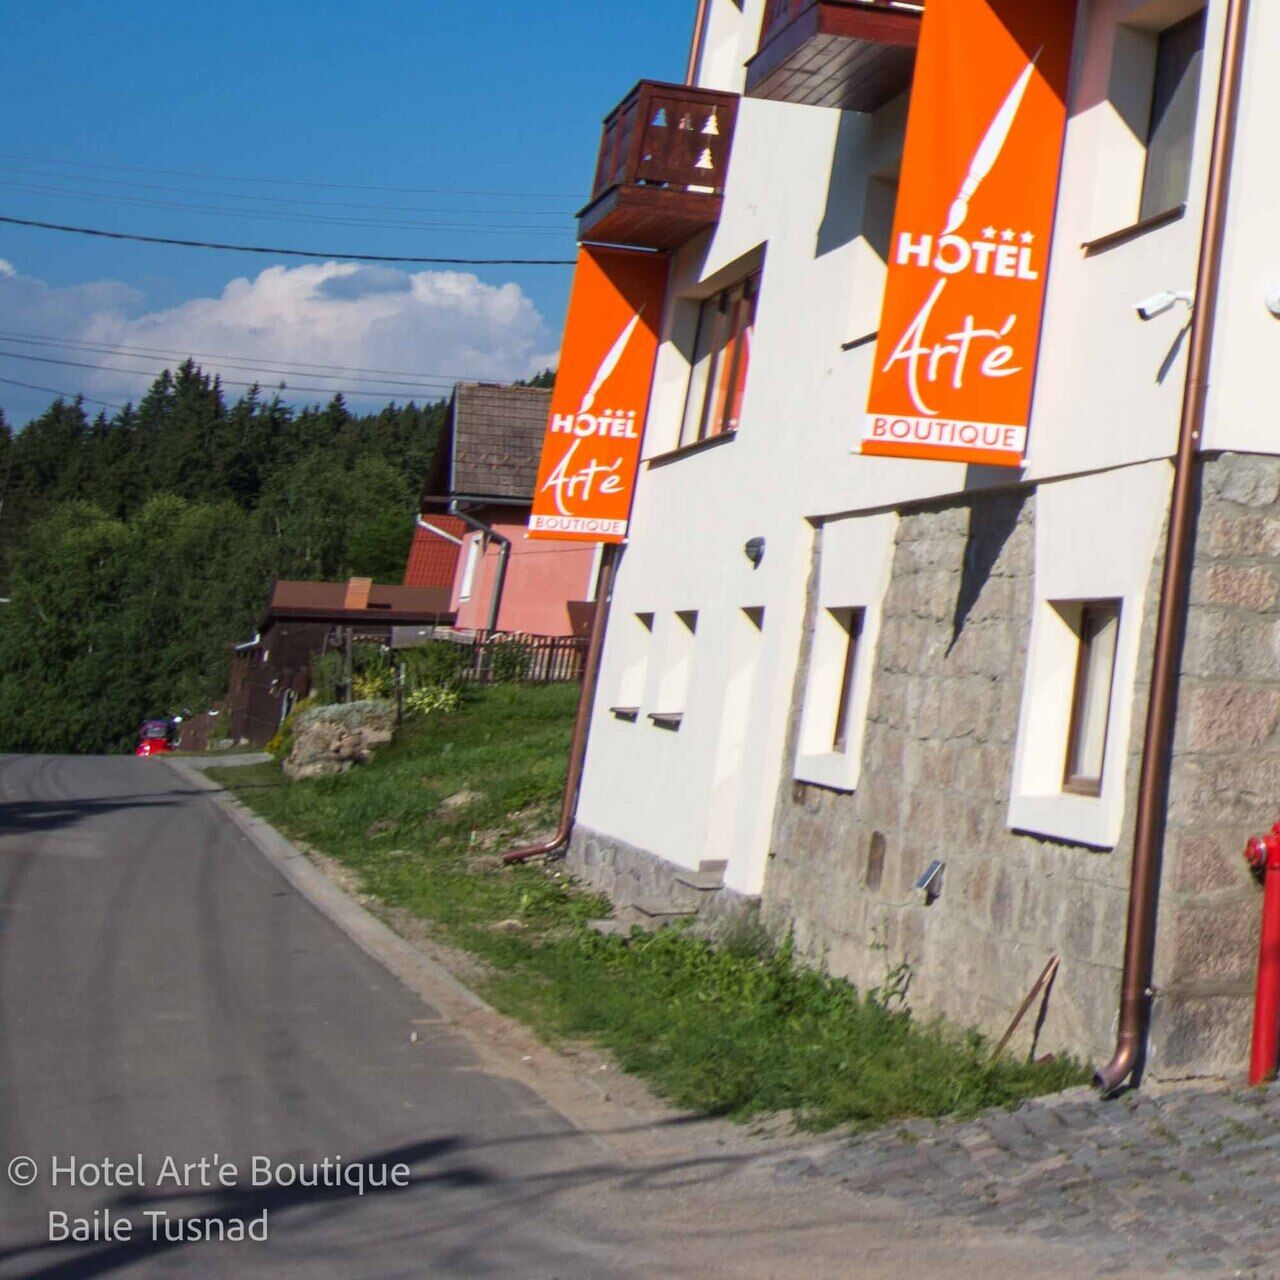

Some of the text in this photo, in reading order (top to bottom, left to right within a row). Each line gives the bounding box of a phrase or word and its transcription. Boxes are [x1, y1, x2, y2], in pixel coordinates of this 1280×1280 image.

[896, 232, 1038, 280] HOTEL
[881, 276, 1023, 416] Arté
[551, 413, 638, 438] HOTEL
[872, 417, 1017, 447] BOUTIQUE
[541, 437, 625, 516] Arté
[535, 517, 621, 533] BOUTIQUE
